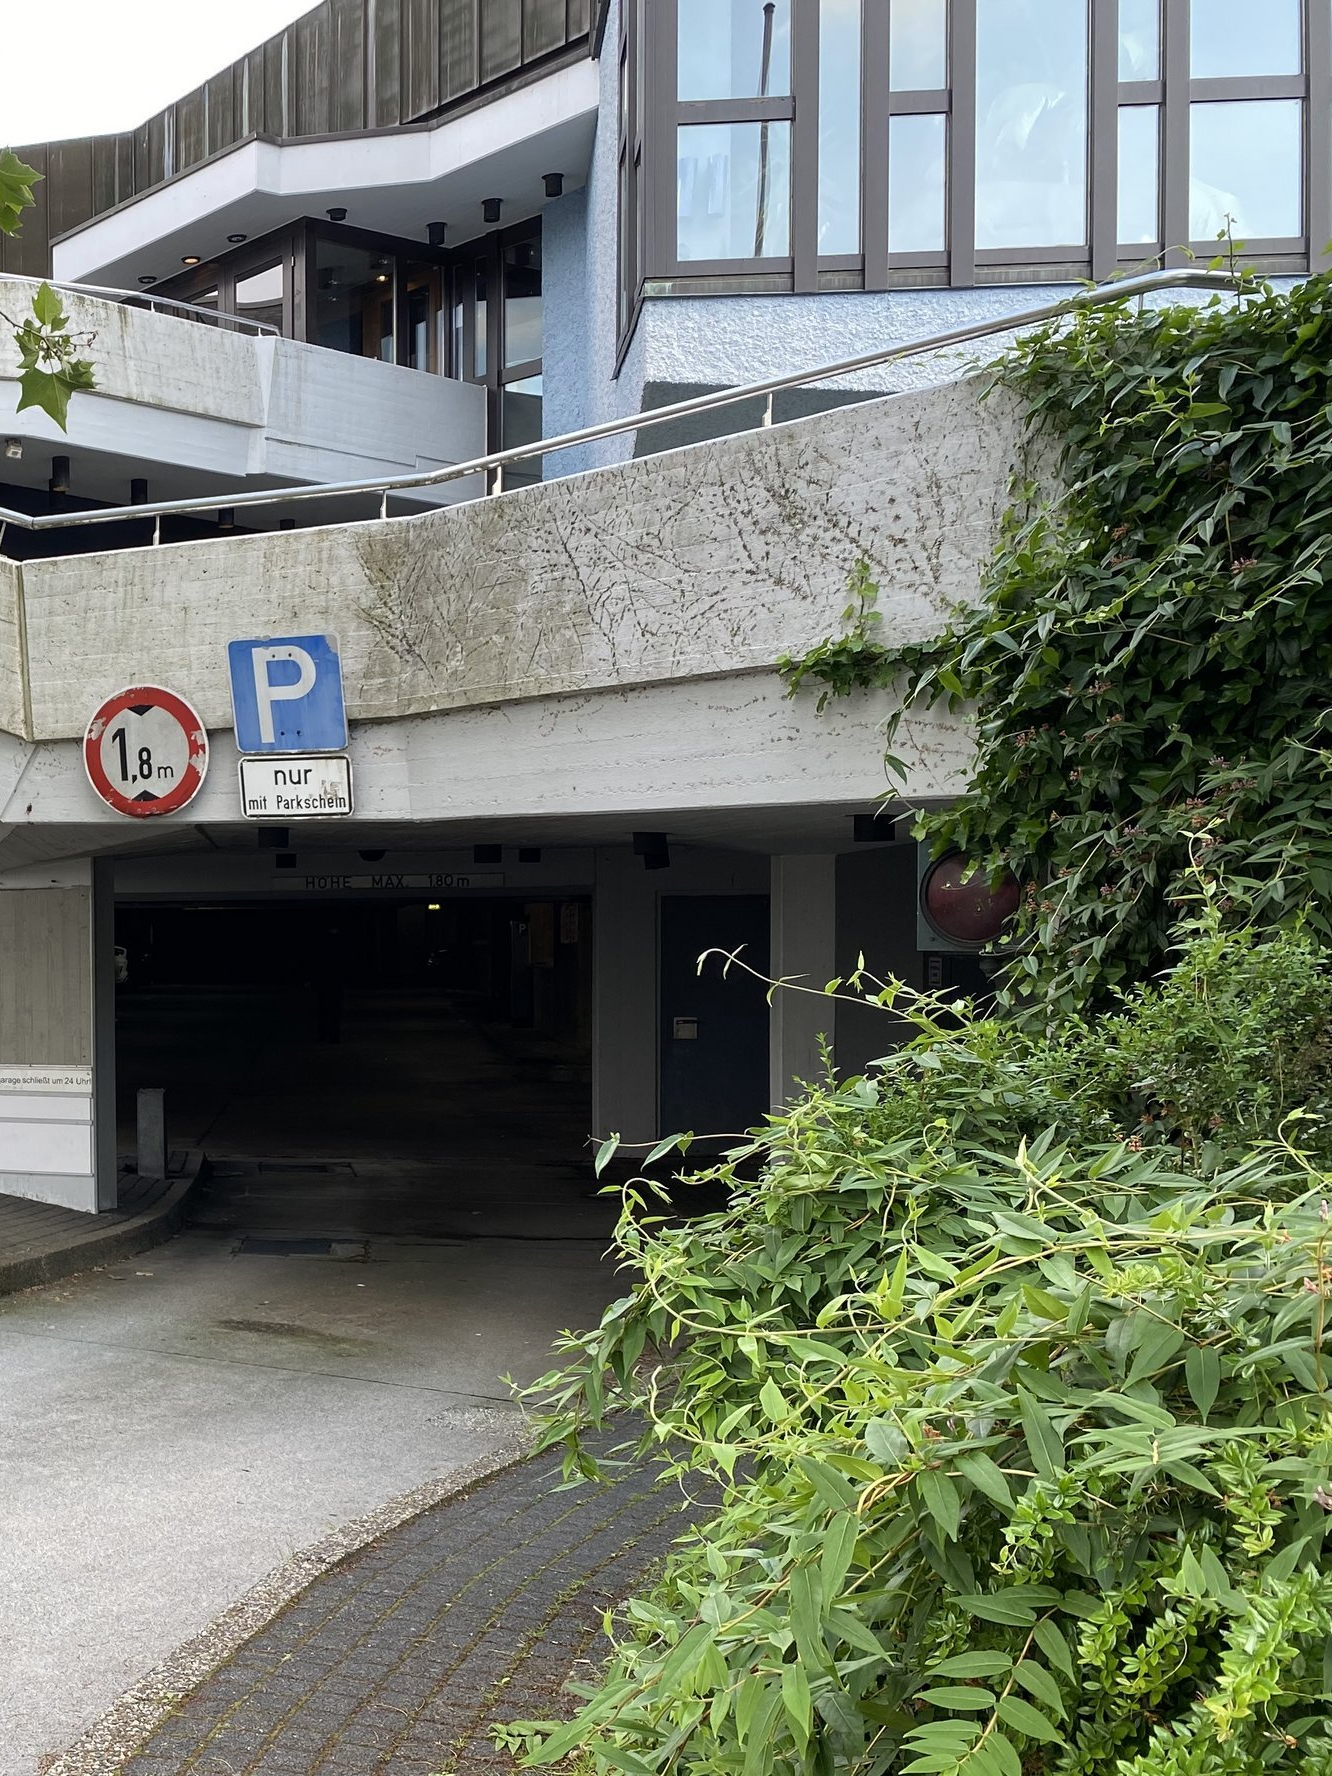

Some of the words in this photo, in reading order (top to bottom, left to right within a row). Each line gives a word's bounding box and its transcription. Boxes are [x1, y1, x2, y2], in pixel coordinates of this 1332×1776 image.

[251, 644, 317, 744] P
[111, 727, 153, 785] 1,8
[157, 765, 174, 779] m
[273, 768, 313, 786] nur
[248, 795, 267, 810] mit
[276, 793, 347, 810] Parkschein
[456, 876, 470, 888] m
[22, 1076, 50, 1085] schließt
[64, 1077, 74, 1085] 24
